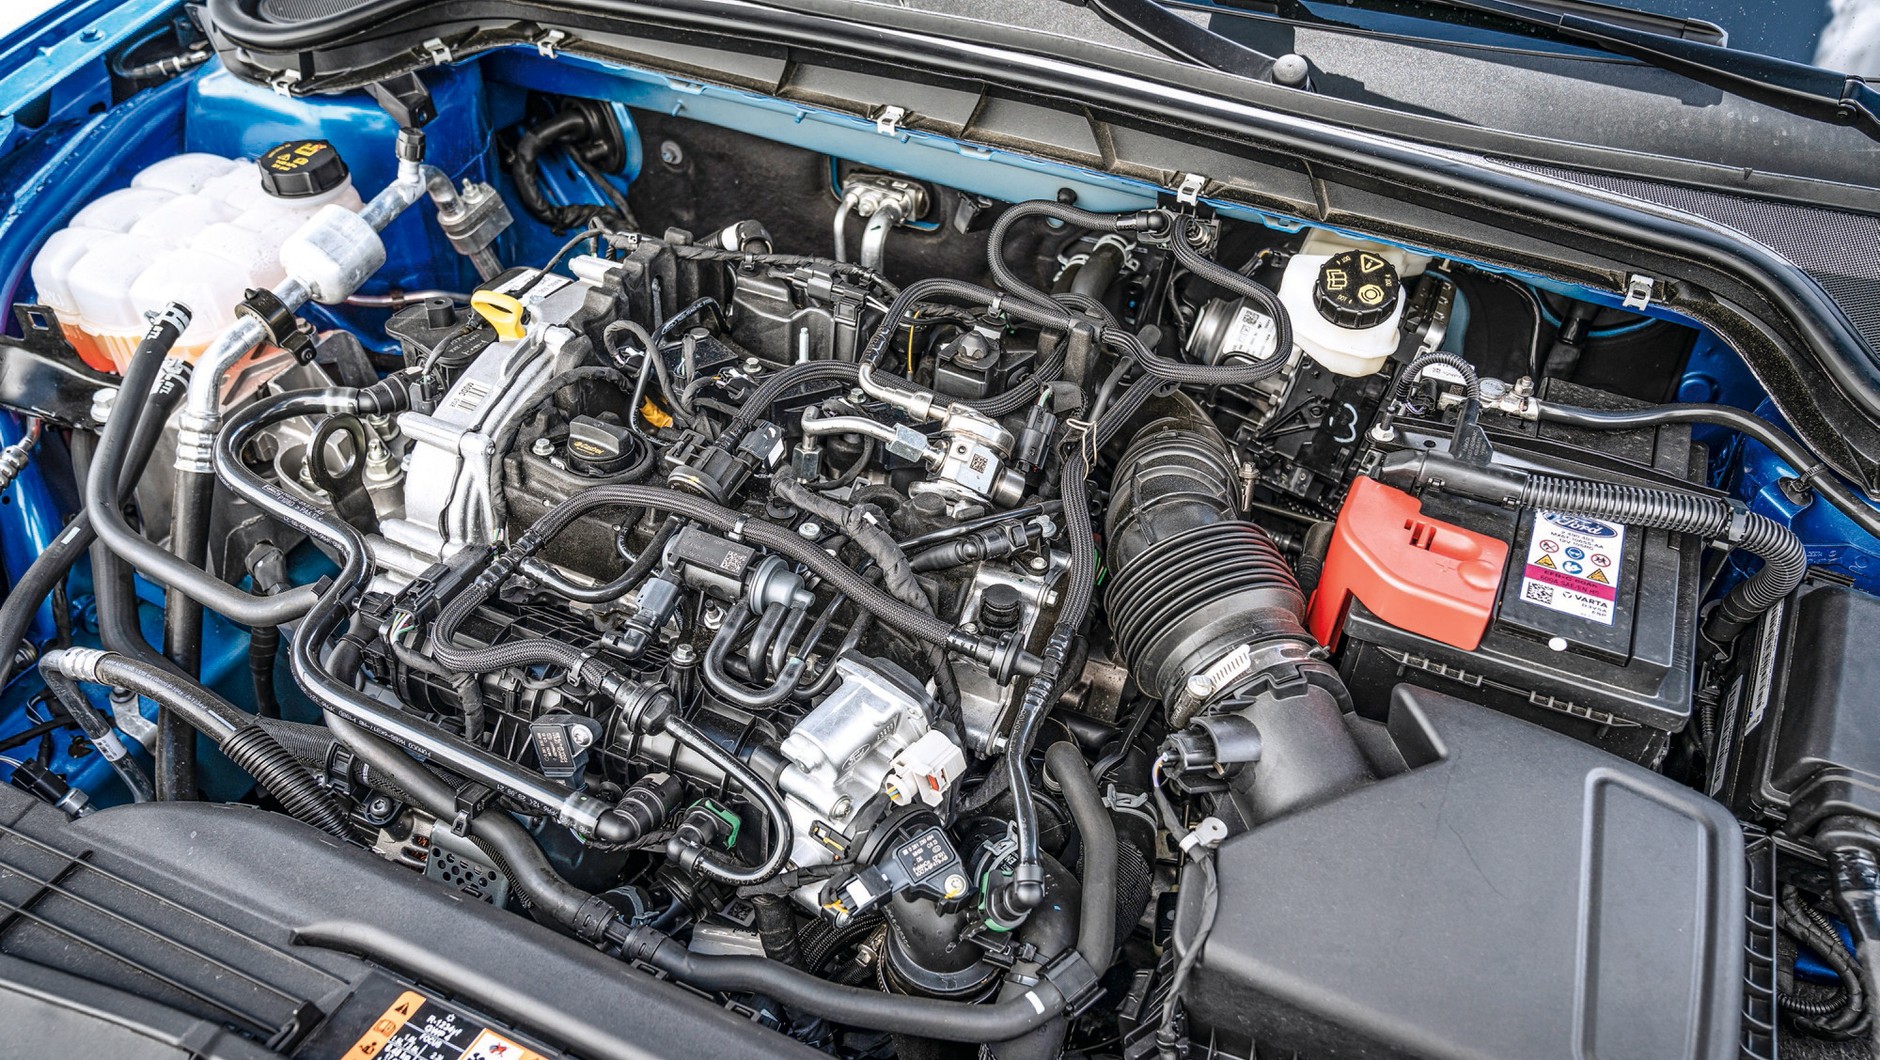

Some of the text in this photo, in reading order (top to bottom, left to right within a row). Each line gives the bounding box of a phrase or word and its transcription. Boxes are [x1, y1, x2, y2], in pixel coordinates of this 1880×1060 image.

[1558, 512, 1603, 535] Ford
[1575, 594, 1608, 608] VARTA
[426, 1014, 463, 1036] R-1234yf
[419, 1032, 443, 1049] FOCUS
